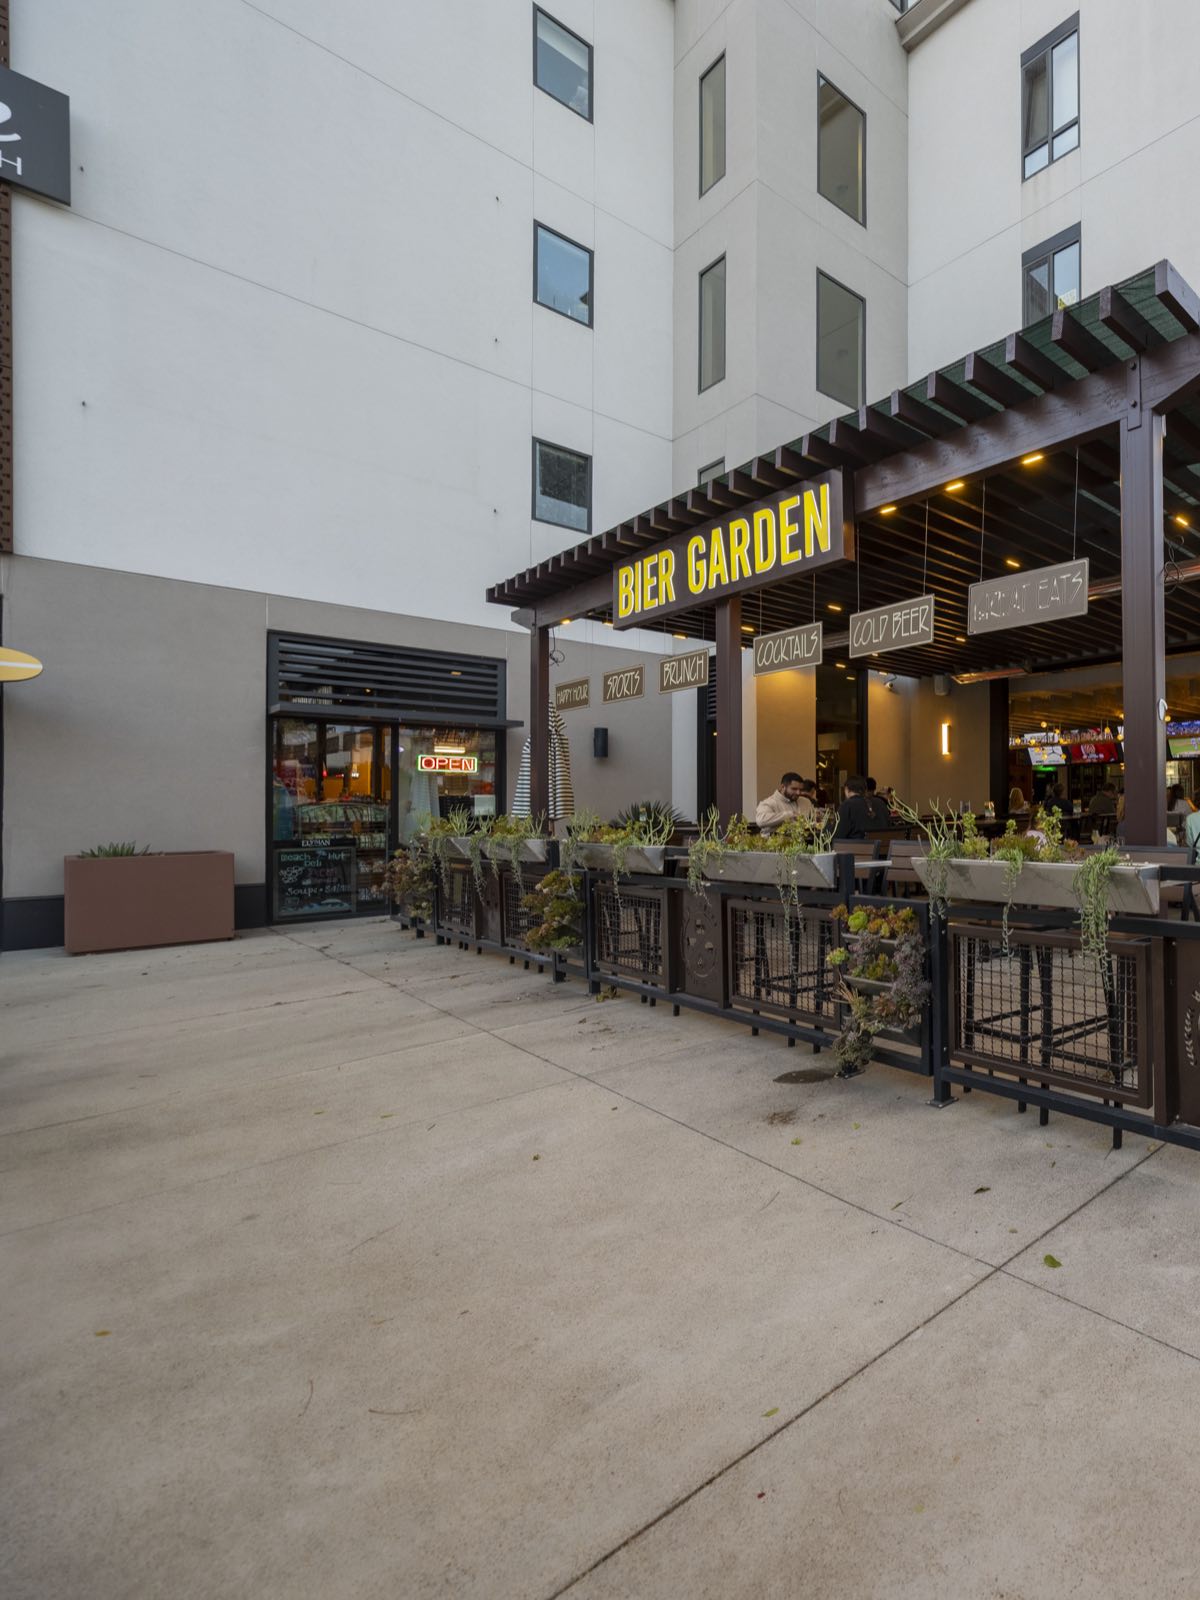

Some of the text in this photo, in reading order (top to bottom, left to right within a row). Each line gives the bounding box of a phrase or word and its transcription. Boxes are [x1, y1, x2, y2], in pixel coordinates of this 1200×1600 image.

[618, 482, 832, 619] BIER GARDEN
[1036, 570, 1083, 610] EATS
[853, 604, 930, 648] COLD BEER
[756, 629, 818, 667] COCKTAILS
[606, 670, 640, 700] SPORTS
[663, 655, 704, 687] BRUNCH
[556, 683, 588, 705] HAPPY HOUR
[421, 756, 474, 771] OPEN
